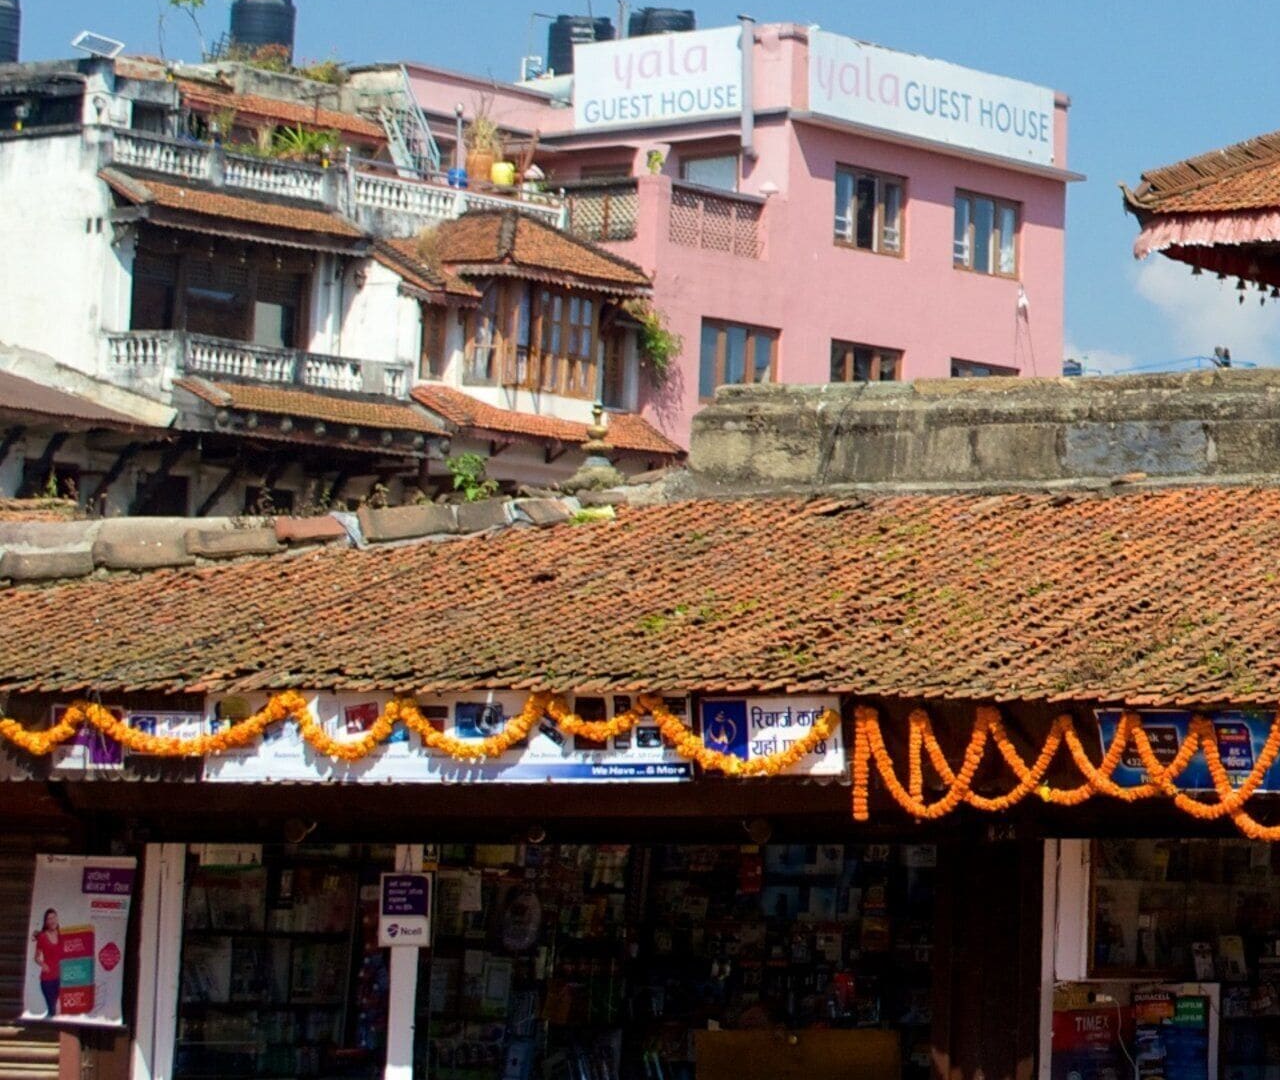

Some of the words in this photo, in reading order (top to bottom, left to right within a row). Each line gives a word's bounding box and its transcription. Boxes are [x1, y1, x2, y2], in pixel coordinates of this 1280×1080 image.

[614, 37, 708, 89] yala
[584, 95, 652, 123] GUEST
[661, 84, 737, 113] HOUSE
[816, 55, 899, 107] yala
[905, 82, 971, 122] GUEST
[980, 98, 1048, 143] HOUSE
[592, 766, 608, 775] We
[609, 766, 635, 775] Have
[656, 766, 686, 775] More
[1075, 1015, 1110, 1032] TIMEX
